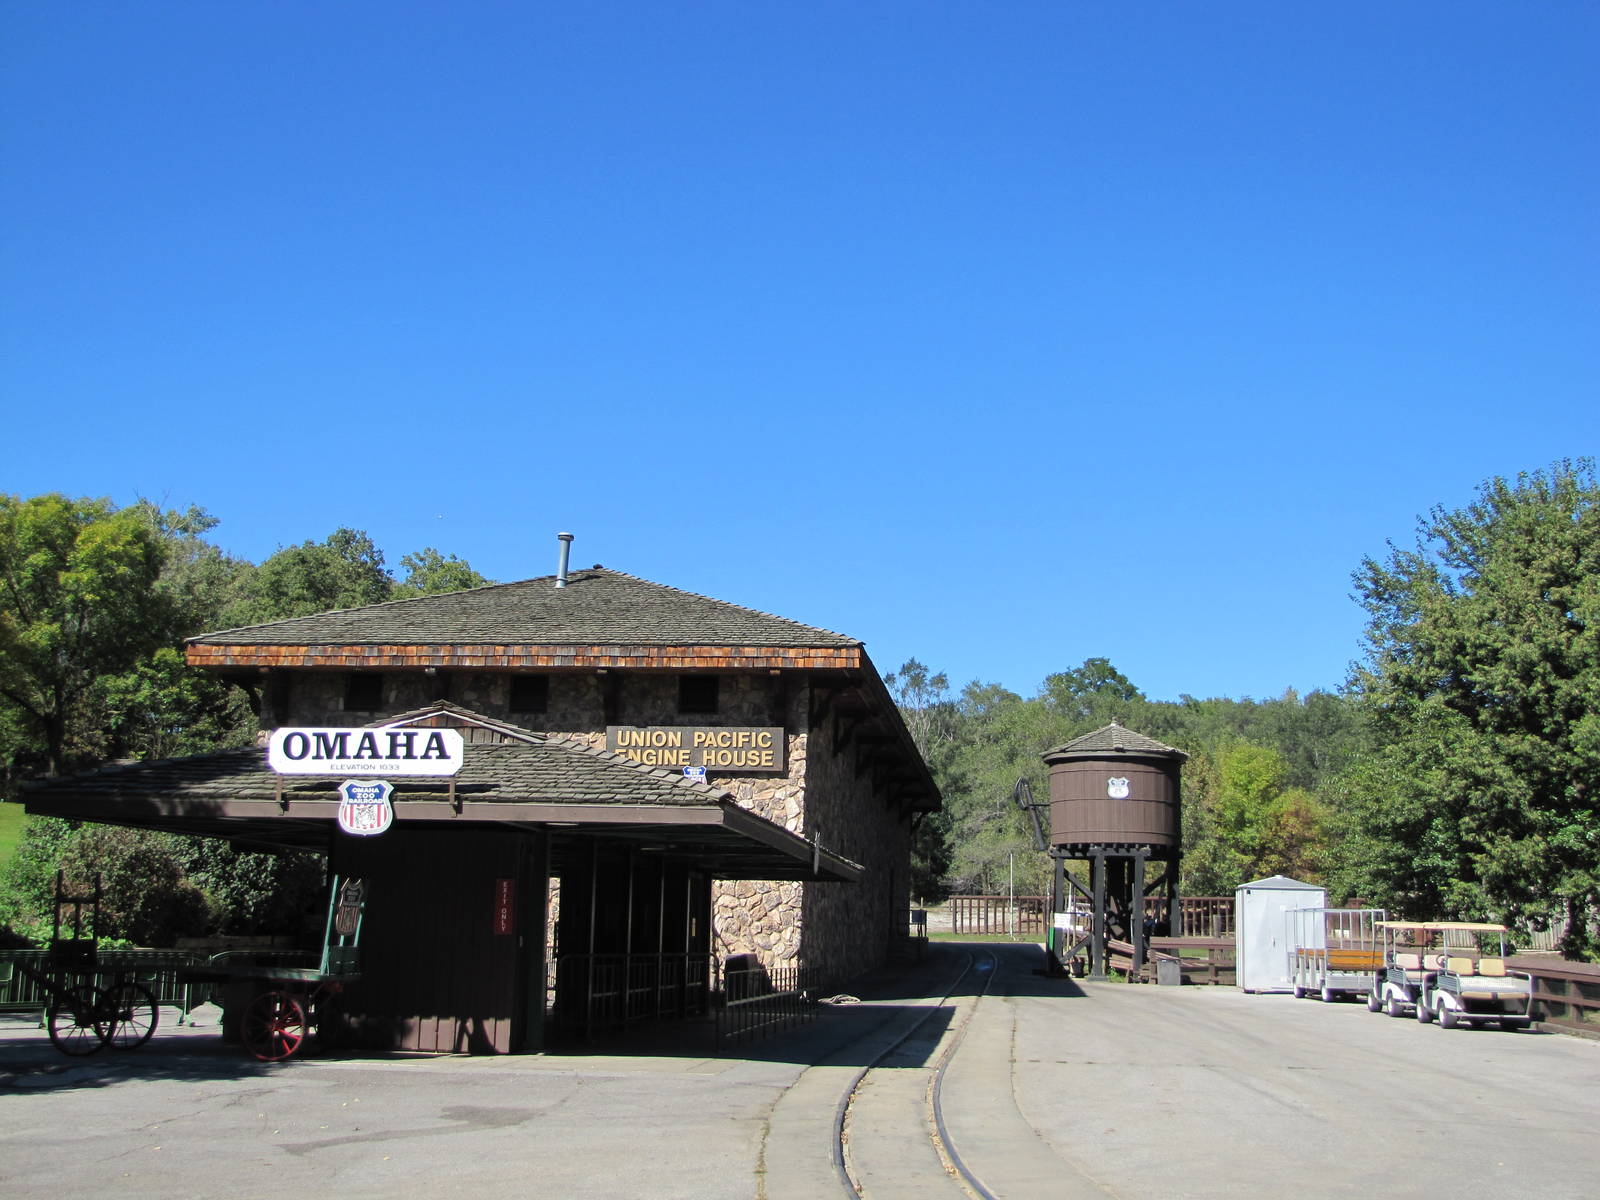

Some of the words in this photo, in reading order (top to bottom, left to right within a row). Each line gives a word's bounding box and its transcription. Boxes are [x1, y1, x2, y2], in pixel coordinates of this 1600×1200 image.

[282, 731, 451, 761] OMAHA
[617, 730, 682, 747] UNION
[693, 731, 773, 748] PACIFIC
[330, 763, 376, 771] ELEVATION
[702, 750, 774, 767] HOUSE
